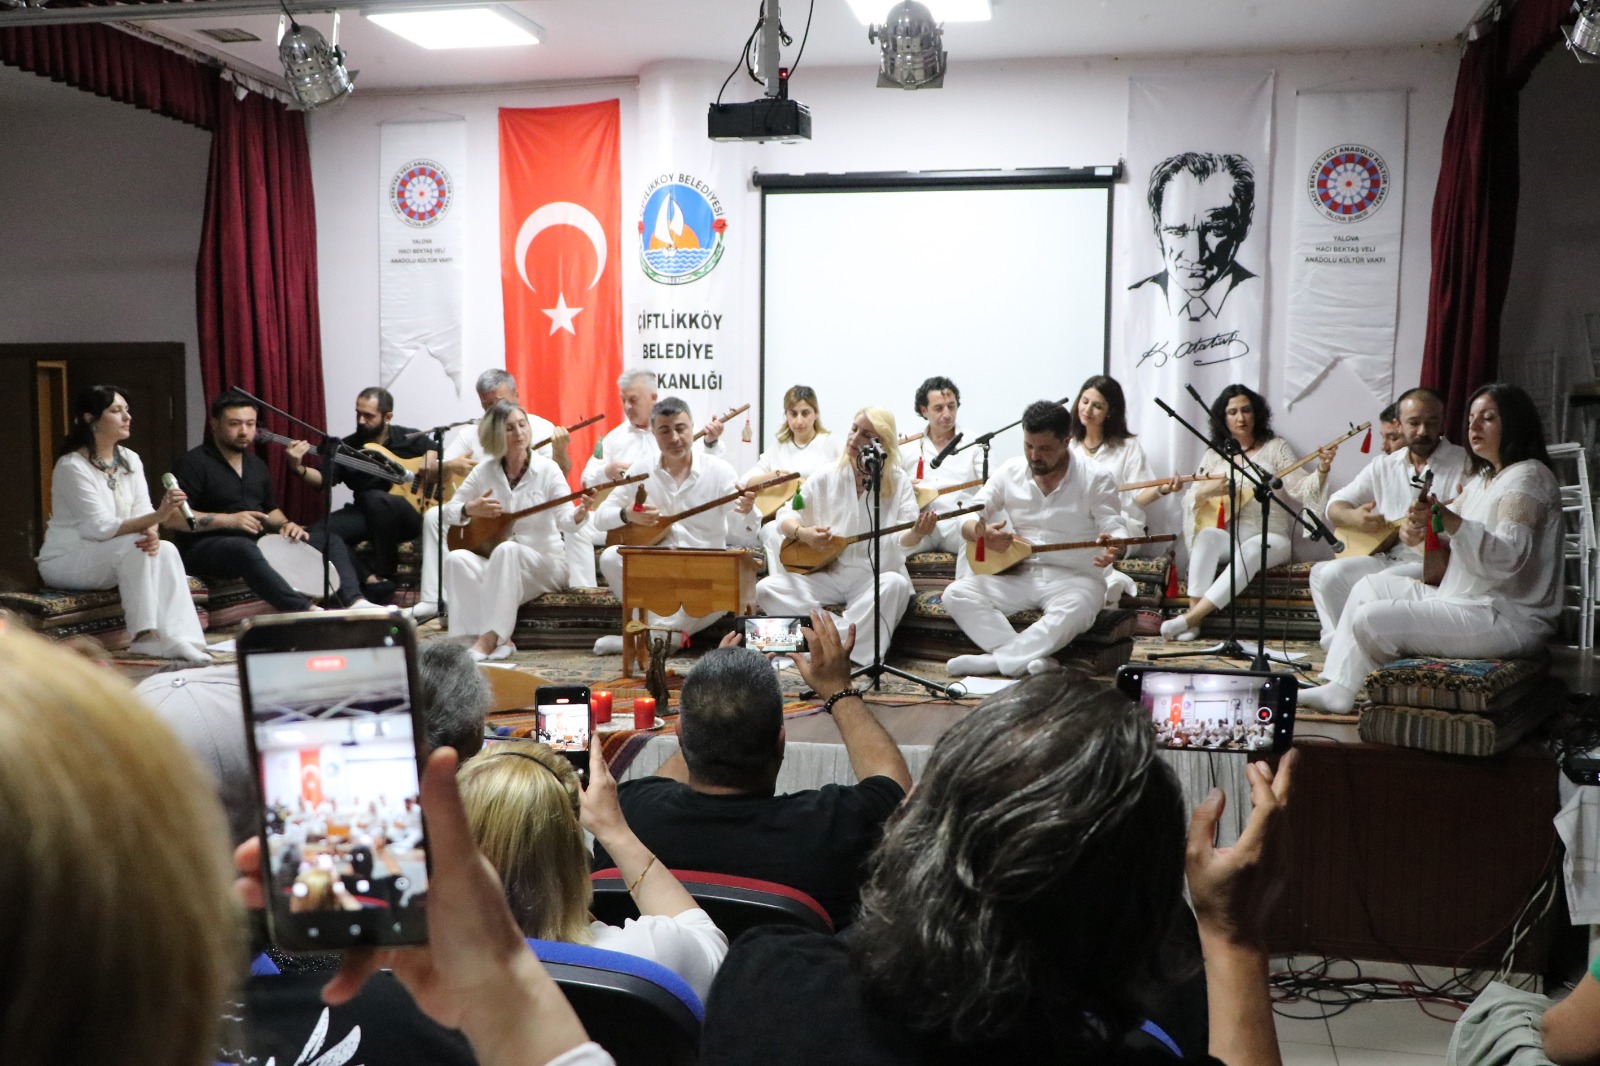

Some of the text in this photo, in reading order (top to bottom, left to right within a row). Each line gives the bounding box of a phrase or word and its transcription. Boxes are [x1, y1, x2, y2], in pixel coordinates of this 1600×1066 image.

[1339, 146, 1375, 159] ANADOLU
[1315, 245, 1376, 254] HACI BEKTAŞ VELİ
[1304, 256, 1386, 264] ANADOLU KÜLTÜR VAKFI
[637, 308, 722, 334] ÇİFTLİKKÖY
[642, 339, 714, 360] BELEDİYE
